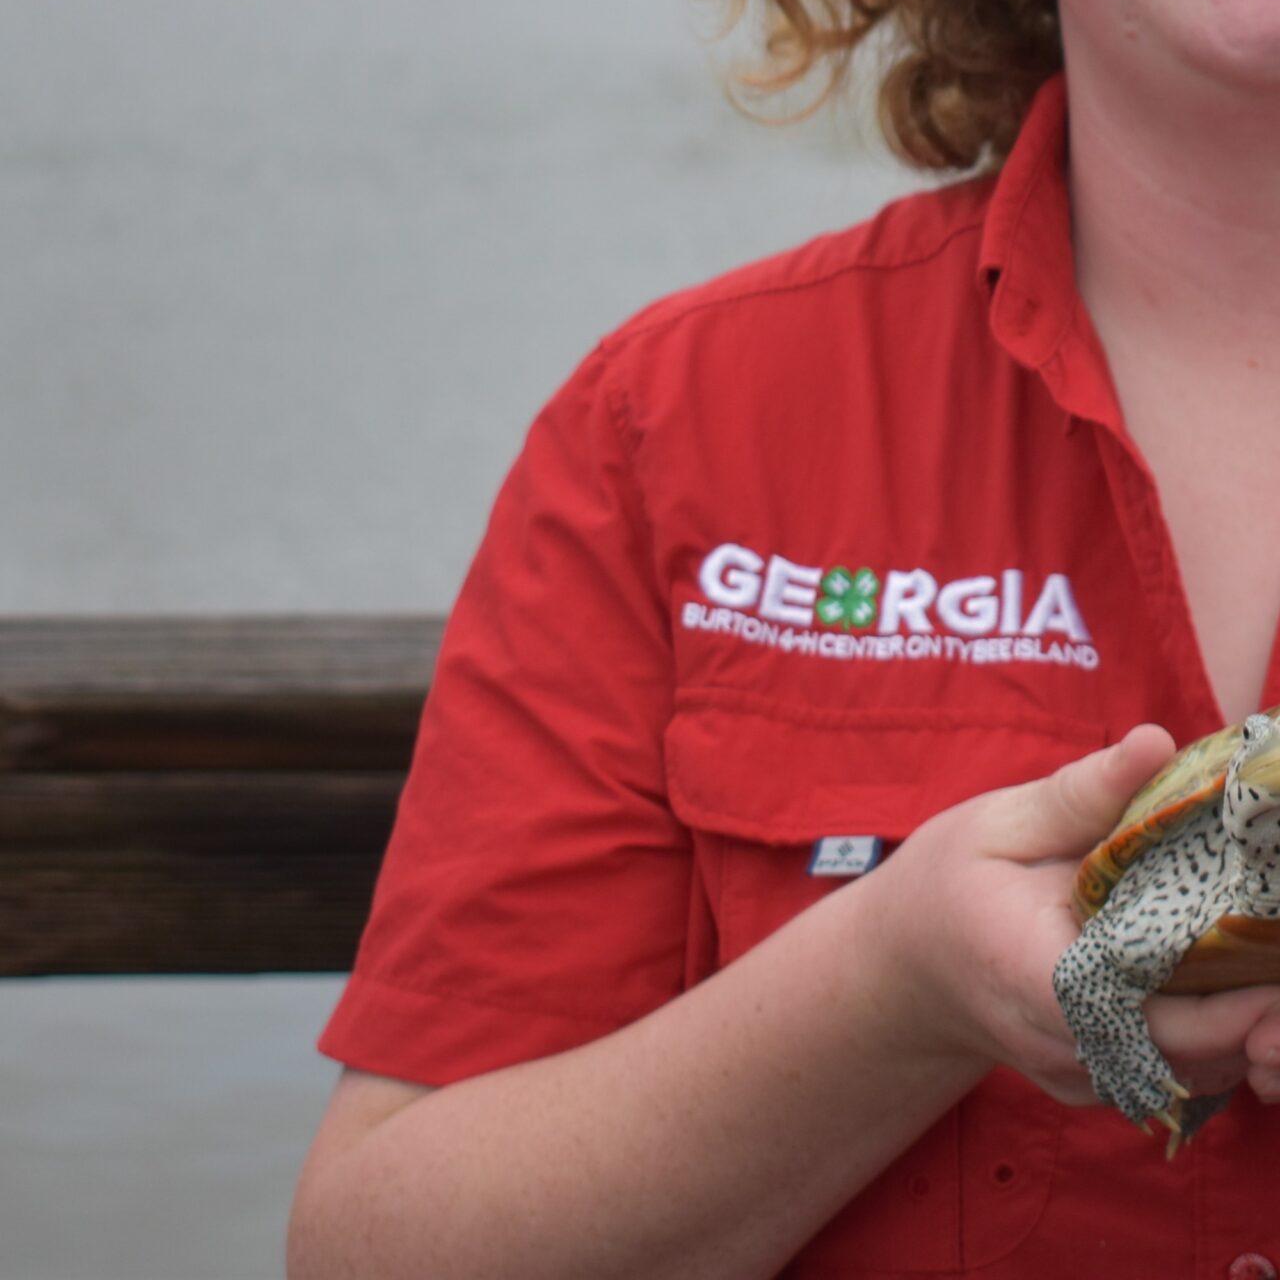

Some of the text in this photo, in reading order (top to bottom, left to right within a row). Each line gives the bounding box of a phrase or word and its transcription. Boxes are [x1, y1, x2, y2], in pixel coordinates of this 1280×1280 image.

[682, 602, 1100, 670] BURTON 4-H CENTER ON TYBEE ISLAND
